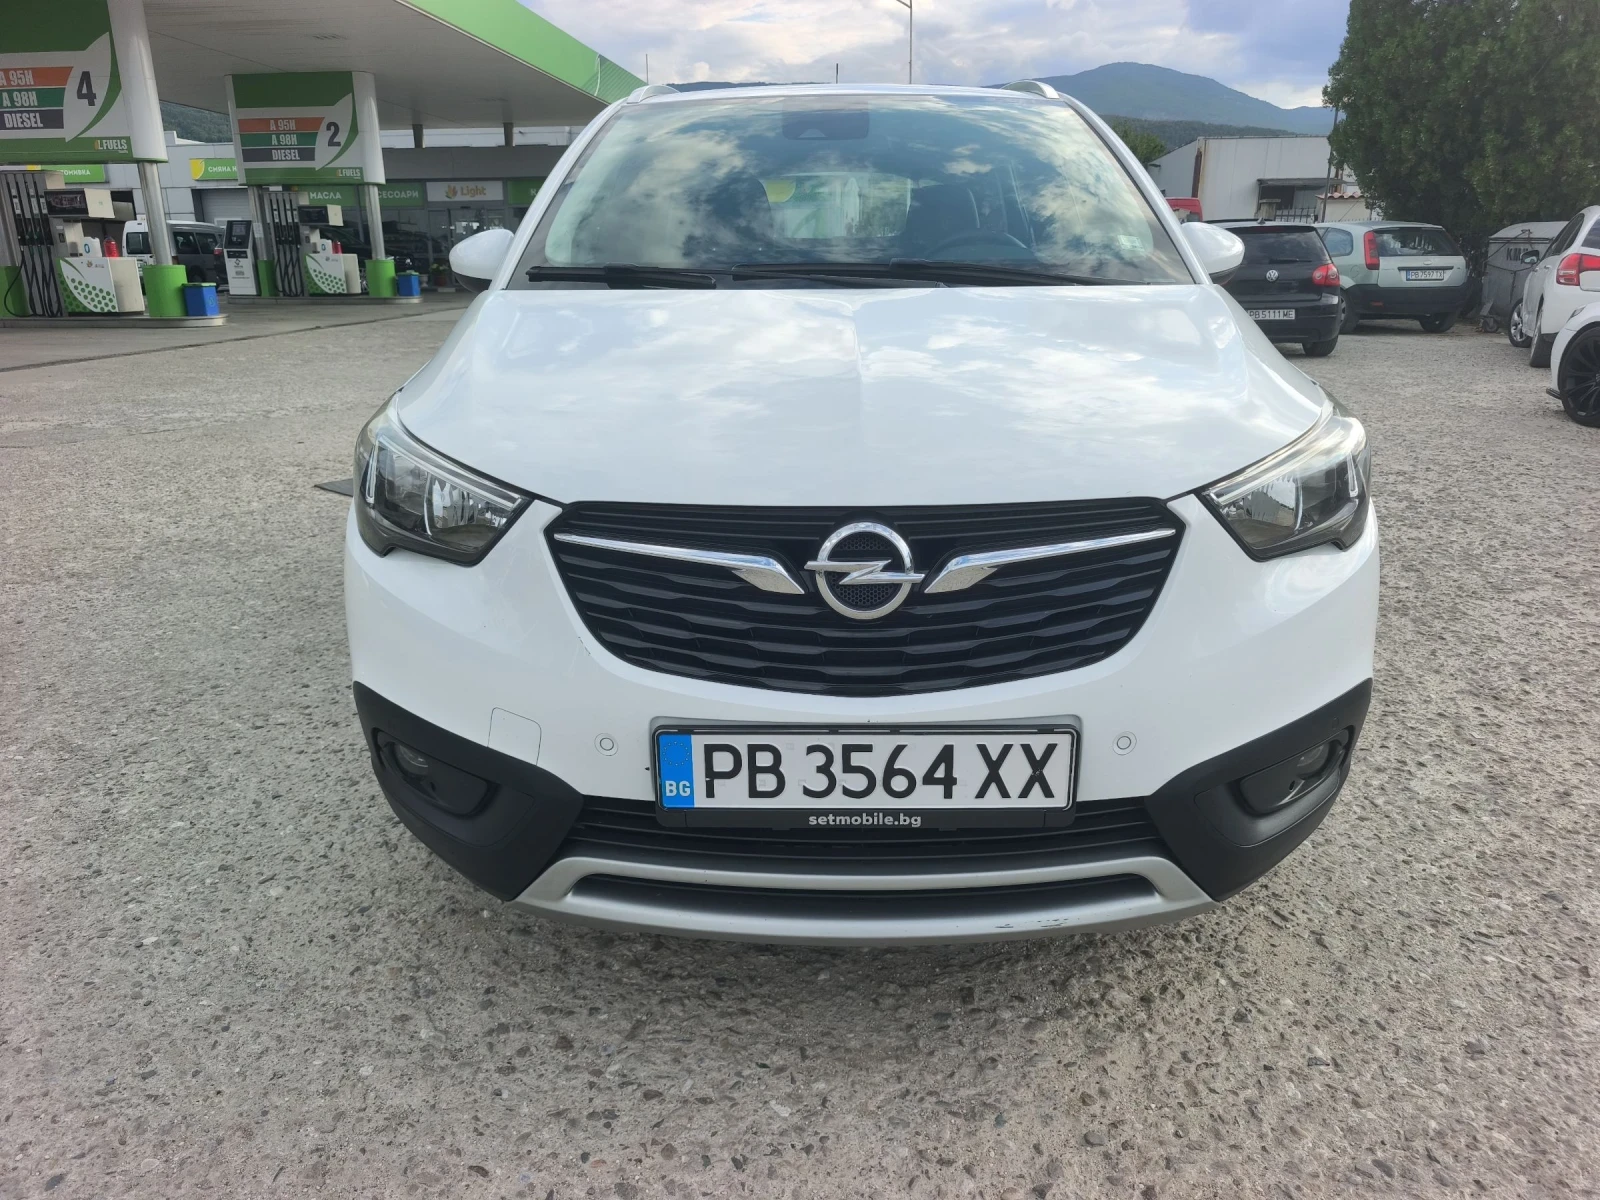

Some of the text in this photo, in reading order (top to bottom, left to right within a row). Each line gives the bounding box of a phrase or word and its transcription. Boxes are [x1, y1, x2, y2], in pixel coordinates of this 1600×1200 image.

[76, 70, 97, 107] 4
[4, 113, 44, 128] DIESEL
[326, 121, 342, 147] 2
[271, 149, 301, 161] DIESEL
[309, 191, 342, 199] МАСЛА
[460, 185, 487, 198] Light
[703, 743, 1058, 799] PB 3564 XX
[664, 780, 691, 798] BG
[808, 812, 922, 828] setmobile.bg
